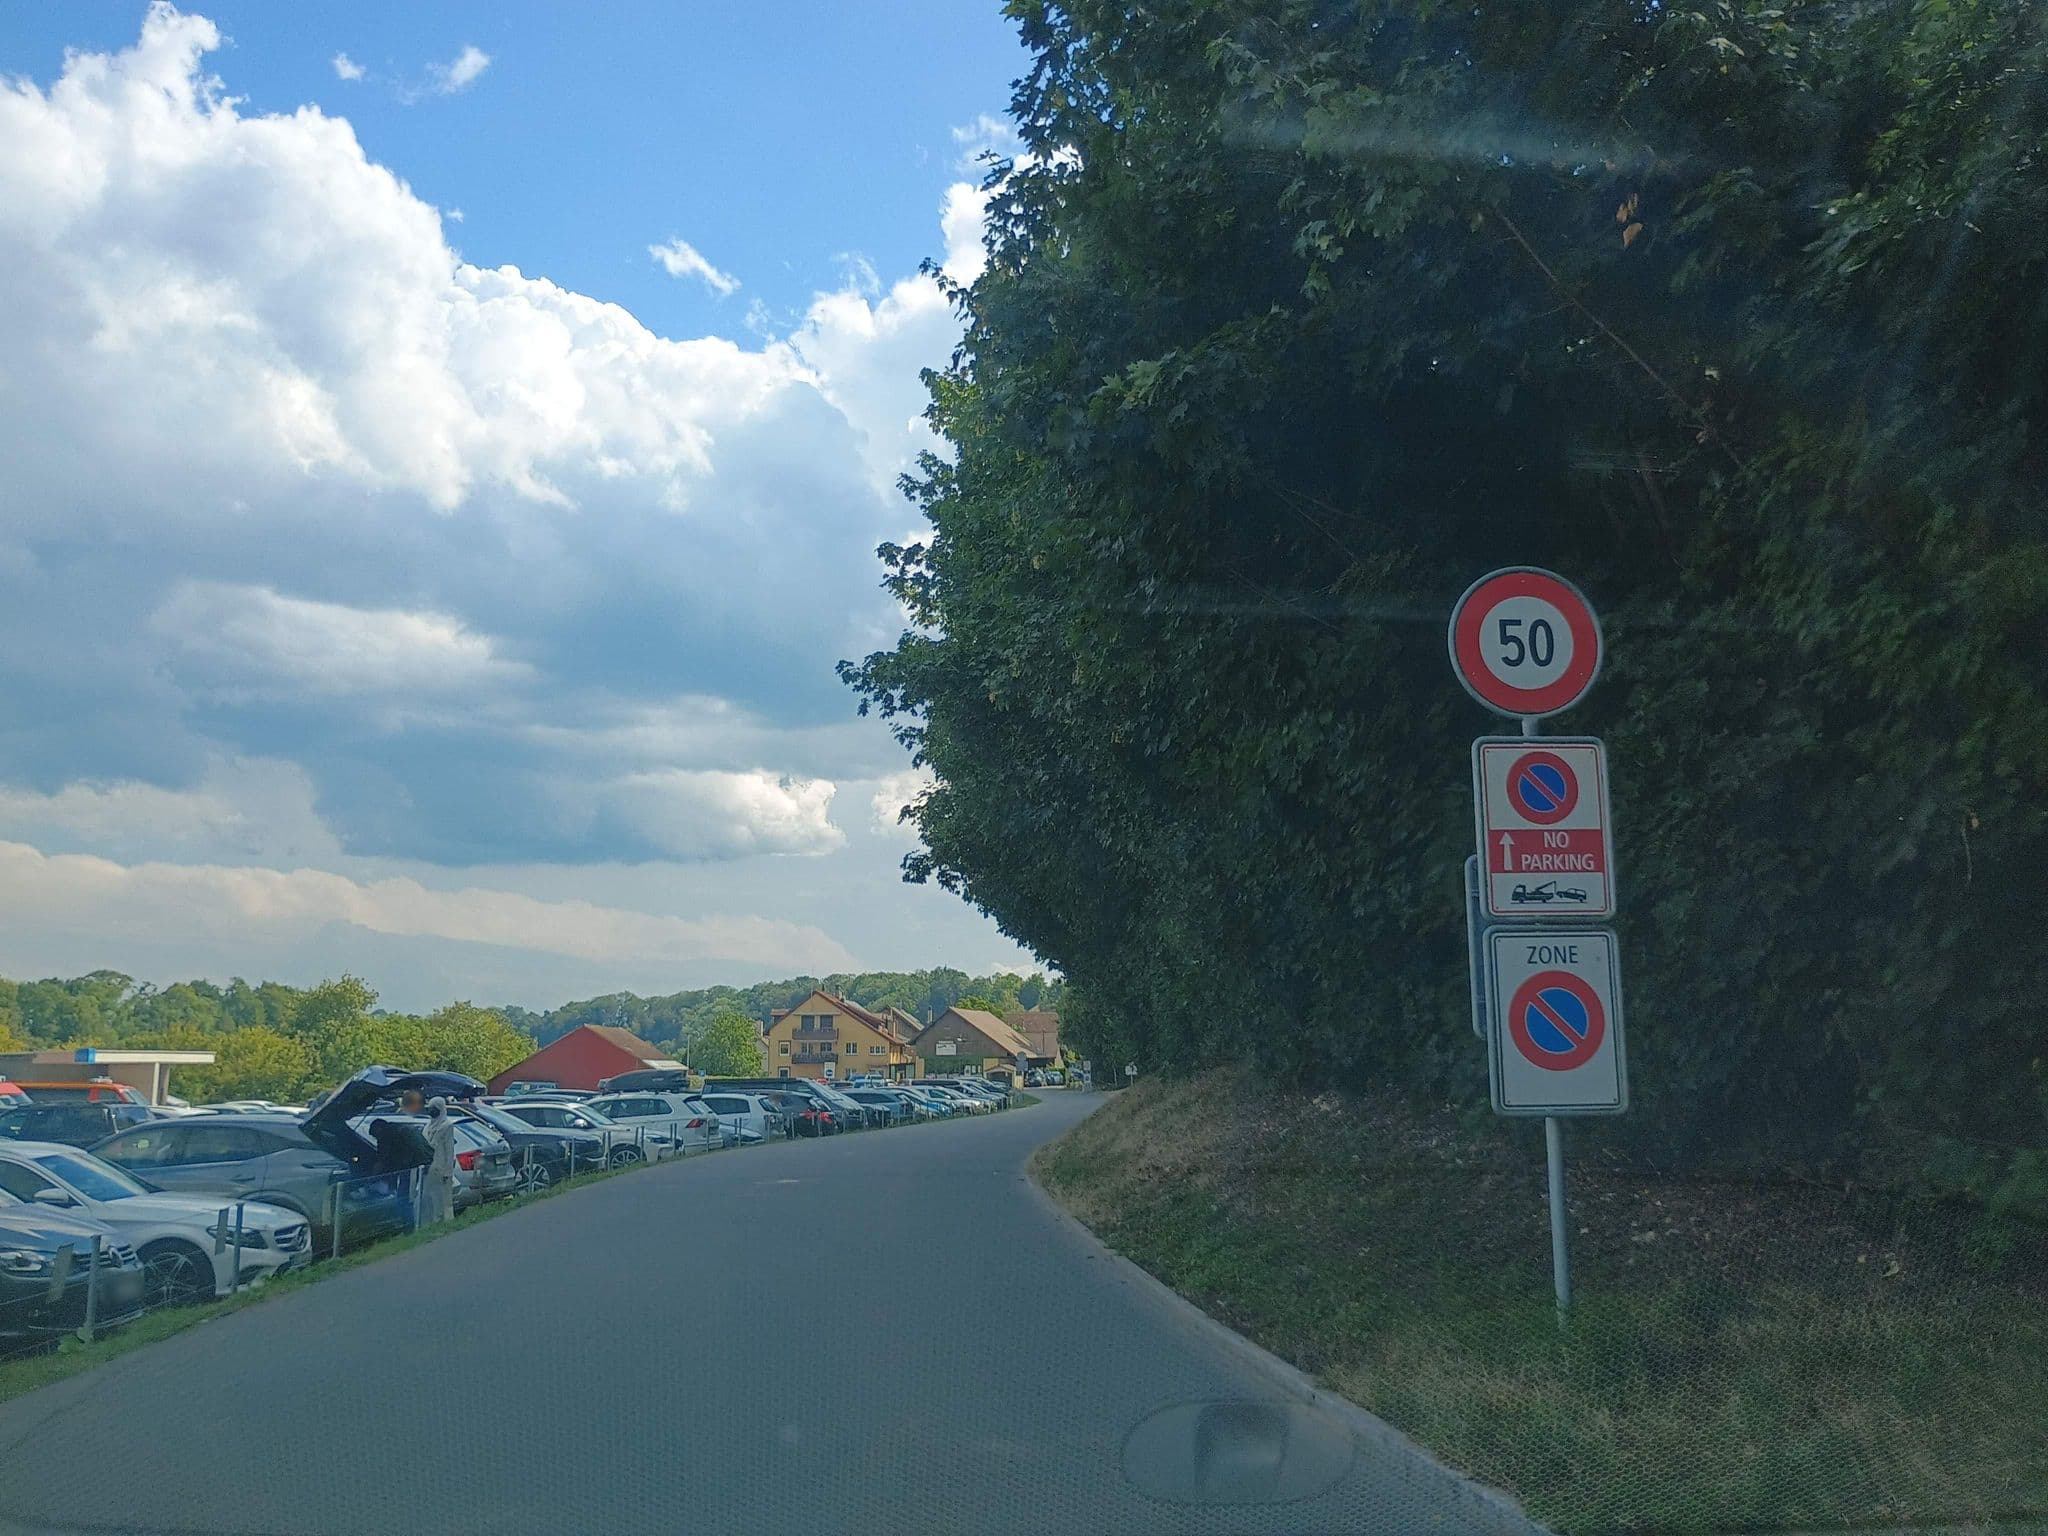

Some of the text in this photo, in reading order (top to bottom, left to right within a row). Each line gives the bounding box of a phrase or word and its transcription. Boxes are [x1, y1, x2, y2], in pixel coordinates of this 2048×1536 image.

[1498, 618, 1554, 667] 50
[1543, 831, 1569, 848] NO
[1521, 854, 1594, 870] PARKING
[1526, 945, 1578, 964] ZONE
